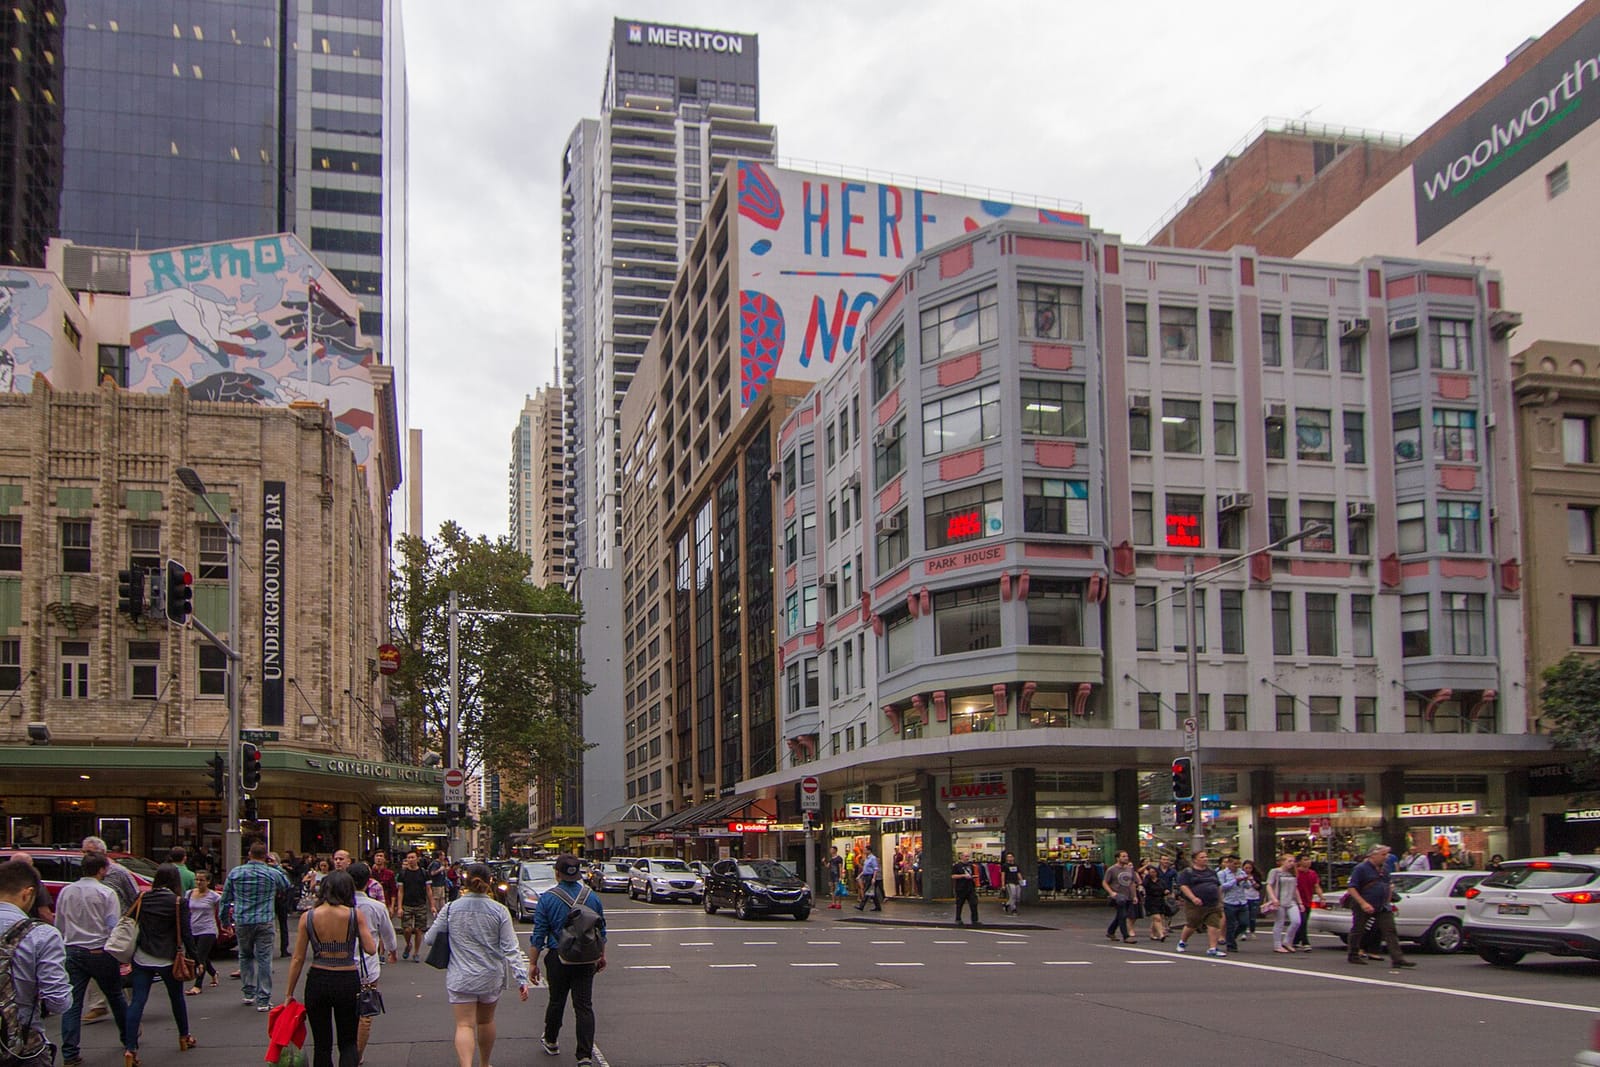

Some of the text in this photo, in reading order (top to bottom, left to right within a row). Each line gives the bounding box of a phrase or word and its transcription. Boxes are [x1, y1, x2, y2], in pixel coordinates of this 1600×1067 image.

[647, 26, 743, 54] MERITON
[1423, 54, 1600, 201] woolworth
[928, 547, 1001, 571] PARK HOUSE
[264, 493, 283, 681] UNDERGROUND BAR
[941, 782, 1008, 798] LOWES
[379, 806, 428, 815] CRITERION
[863, 806, 902, 816] LOWES
[1413, 803, 1459, 815] LOWES
